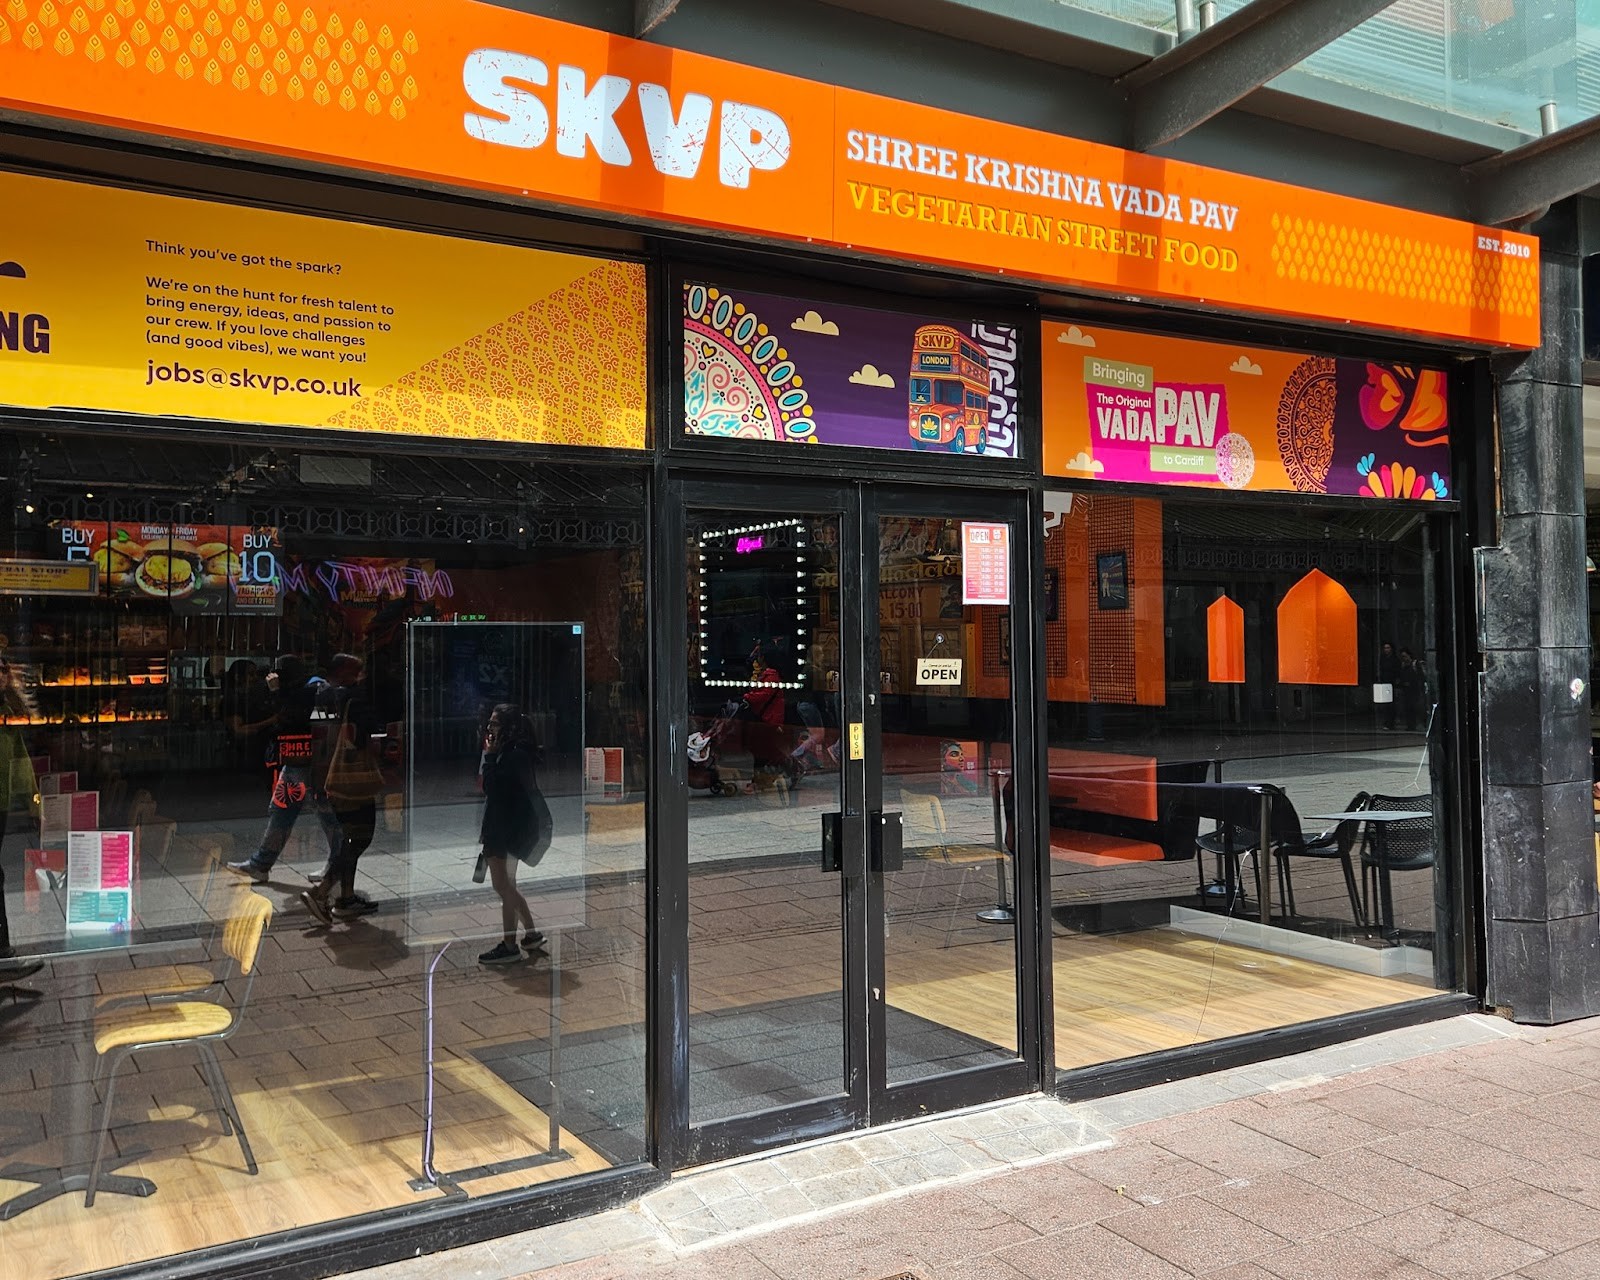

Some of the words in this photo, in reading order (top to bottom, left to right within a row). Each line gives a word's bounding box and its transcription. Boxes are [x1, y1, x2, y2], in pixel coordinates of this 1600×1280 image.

[463, 48, 791, 188] SKVP
[847, 129, 958, 179] SHREE
[964, 153, 1103, 207] KRISHNA
[1107, 181, 1184, 223] VADA
[1189, 198, 1239, 232] PAV
[847, 180, 1053, 243] VEGETARIAN
[1057, 220, 1158, 260] STREET
[1164, 238, 1239, 273] FOOD
[145, 239, 185, 255] Think
[190, 247, 237, 262] you've
[241, 254, 265, 266] got
[269, 256, 292, 269] the
[296, 261, 341, 275] spark?
[146, 276, 188, 291] We're
[193, 285, 211, 294] on
[215, 285, 239, 297] the
[243, 288, 275, 301] hunt
[279, 292, 297, 304] for
[301, 294, 334, 308] fresh
[338, 300, 377, 313] talent
[381, 304, 394, 315] to
[146, 294, 185, 312] bring
[189, 302, 242, 317] energy,
[247, 305, 289, 322] ideas,
[293, 313, 320, 324] and
[324, 316, 374, 329] passion
[378, 321, 391, 331] to
[0, 310, 50, 354] NG
[146, 315, 170, 325] our
[175, 318, 212, 330] crew.
[217, 320, 227, 331] If
[230, 324, 255, 335] you
[259, 324, 288, 337] love
[292, 329, 366, 346] challenges
[146, 329, 180, 344] (and
[185, 337, 223, 349] good
[227, 340, 273, 355] vibes),
[277, 346, 297, 356] we
[301, 348, 335, 359] want
[339, 352, 367, 363] you!
[921, 334, 951, 348] SKVP
[922, 355, 950, 365] LONDON
[1092, 362, 1145, 387] Bringing
[145, 359, 361, 397] jobs@skvp.co.uk
[1096, 392, 1114, 405] The
[1115, 395, 1151, 409] Original
[1096, 407, 1155, 442] VADA
[1155, 387, 1220, 447] PAV
[1164, 455, 1173, 465] to
[1174, 455, 1204, 466] Cardiff
[62, 527, 95, 544] BUY
[142, 525, 169, 535] MONDAY
[176, 527, 198, 536] FRIDAY
[243, 534, 271, 548] BUY
[970, 531, 989, 542] OPEN
[239, 551, 275, 582] 10
[921, 669, 958, 680] OPEN
